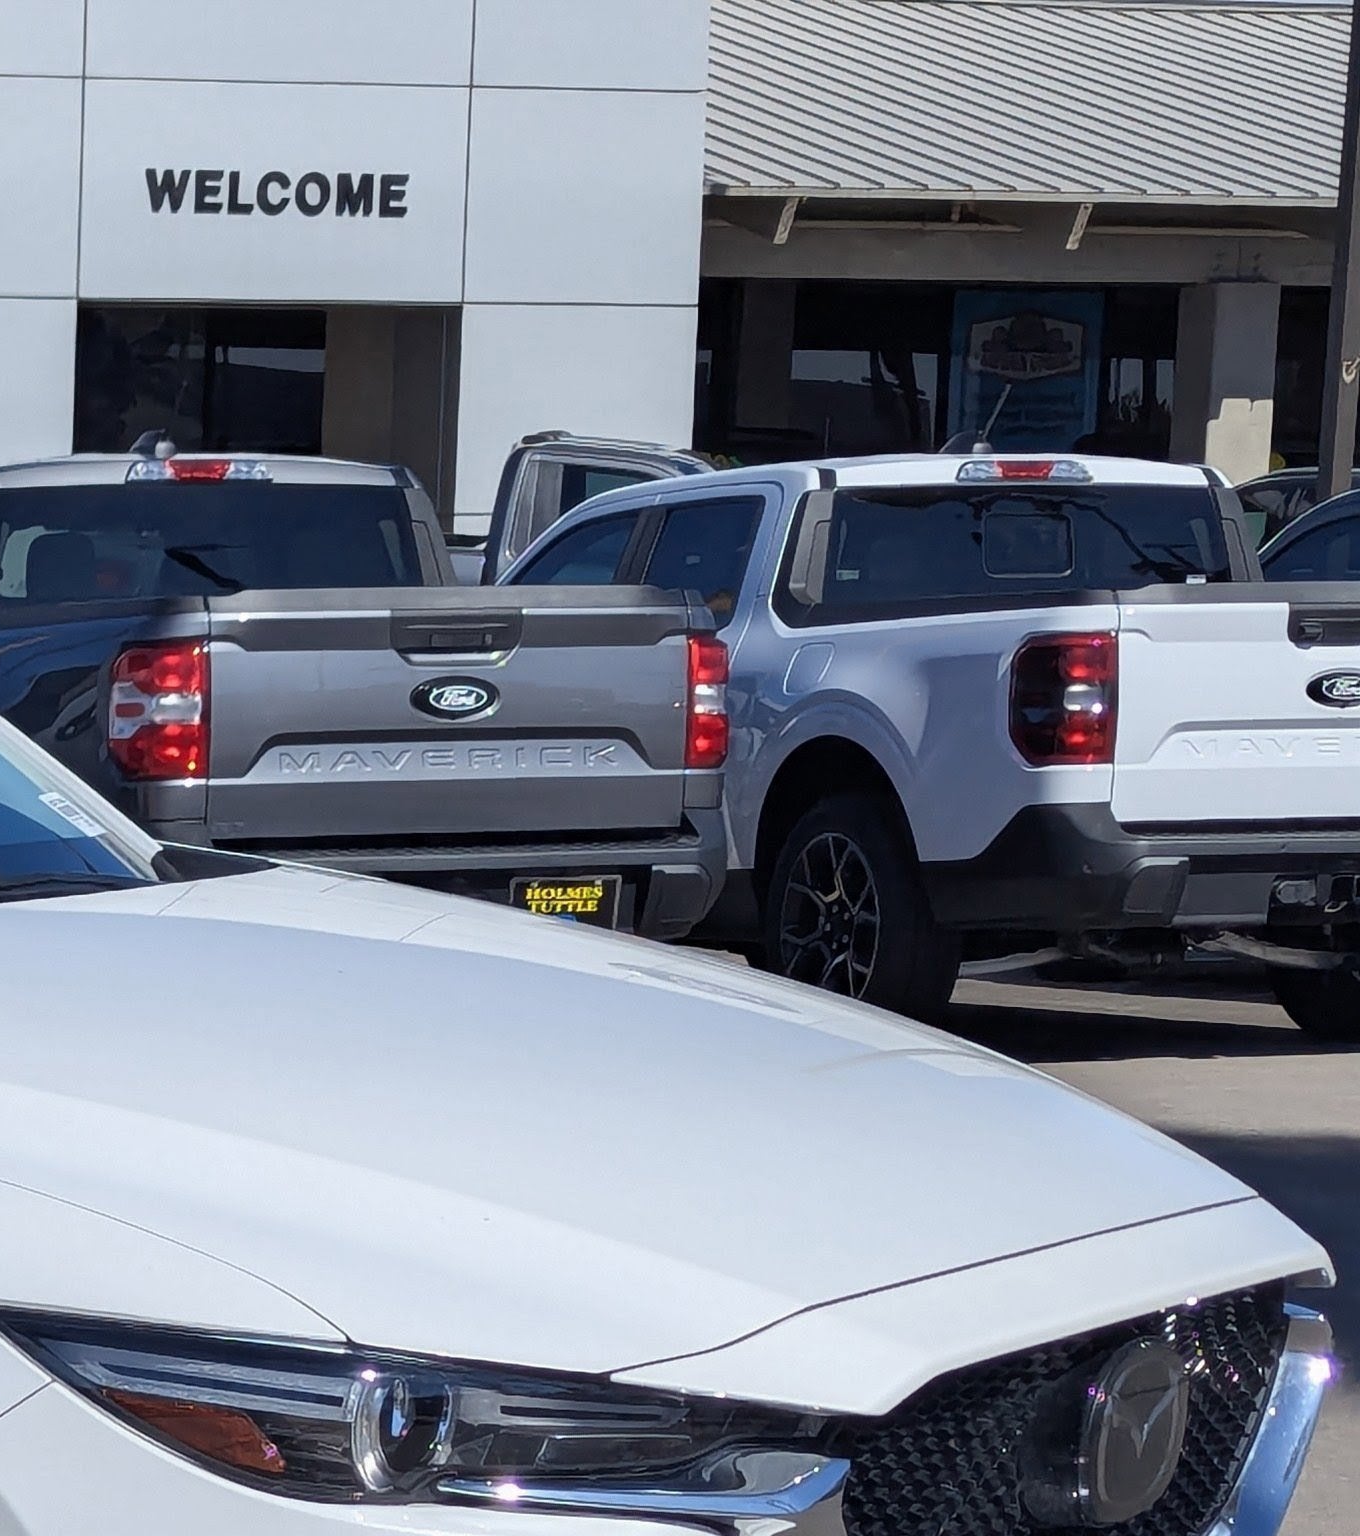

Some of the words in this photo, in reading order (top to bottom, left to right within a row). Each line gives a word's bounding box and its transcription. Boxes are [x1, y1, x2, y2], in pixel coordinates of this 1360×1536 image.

[144, 167, 410, 218] WELCOME
[278, 745, 619, 774] MAVERICK
[525, 886, 603, 900] HOLMES
[527, 900, 599, 914] TUTTLE
